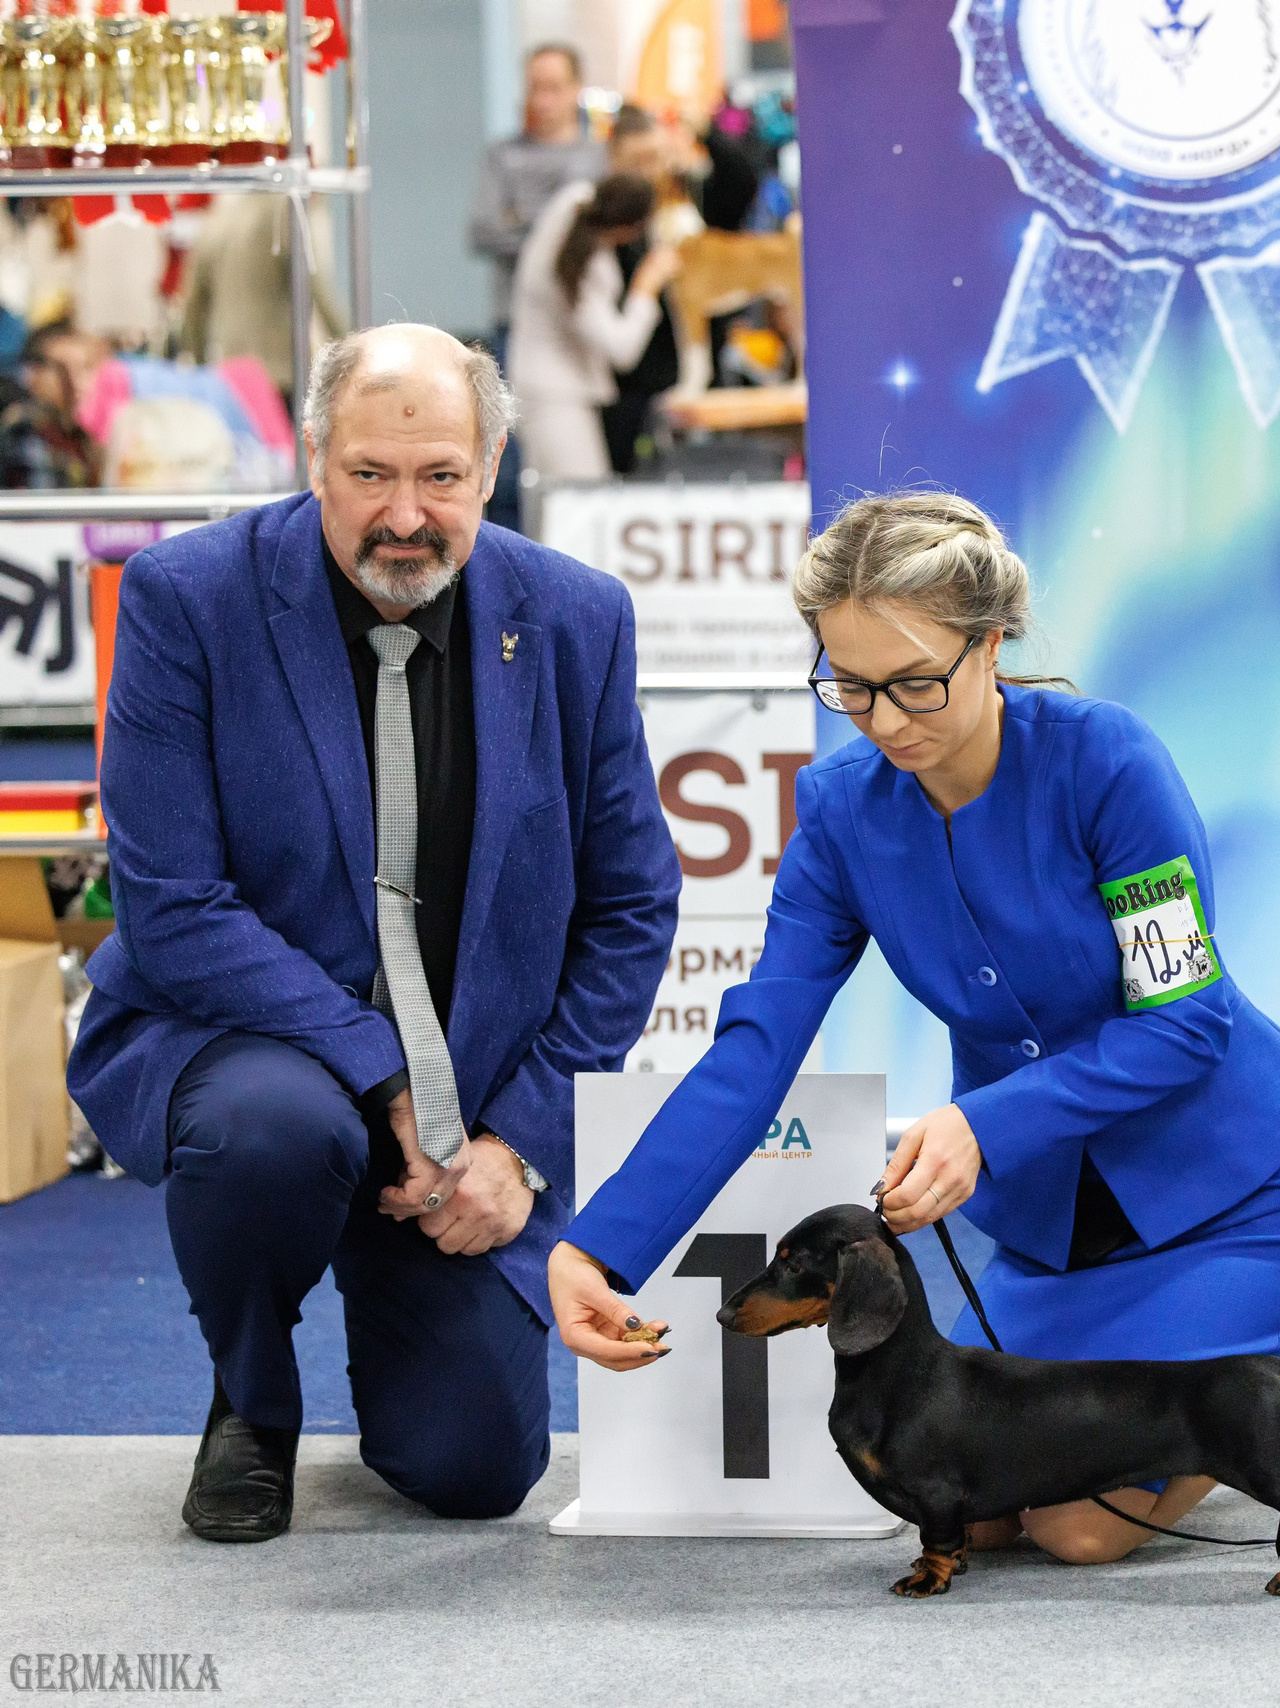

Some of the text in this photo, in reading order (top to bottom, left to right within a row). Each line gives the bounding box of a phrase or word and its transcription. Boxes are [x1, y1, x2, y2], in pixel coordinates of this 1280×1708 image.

[621, 518, 807, 583] SIRI
[643, 1005, 707, 1036] ля
[781, 1151, 813, 1160] ЦЕНТР
[672, 1233, 770, 1479] 1
